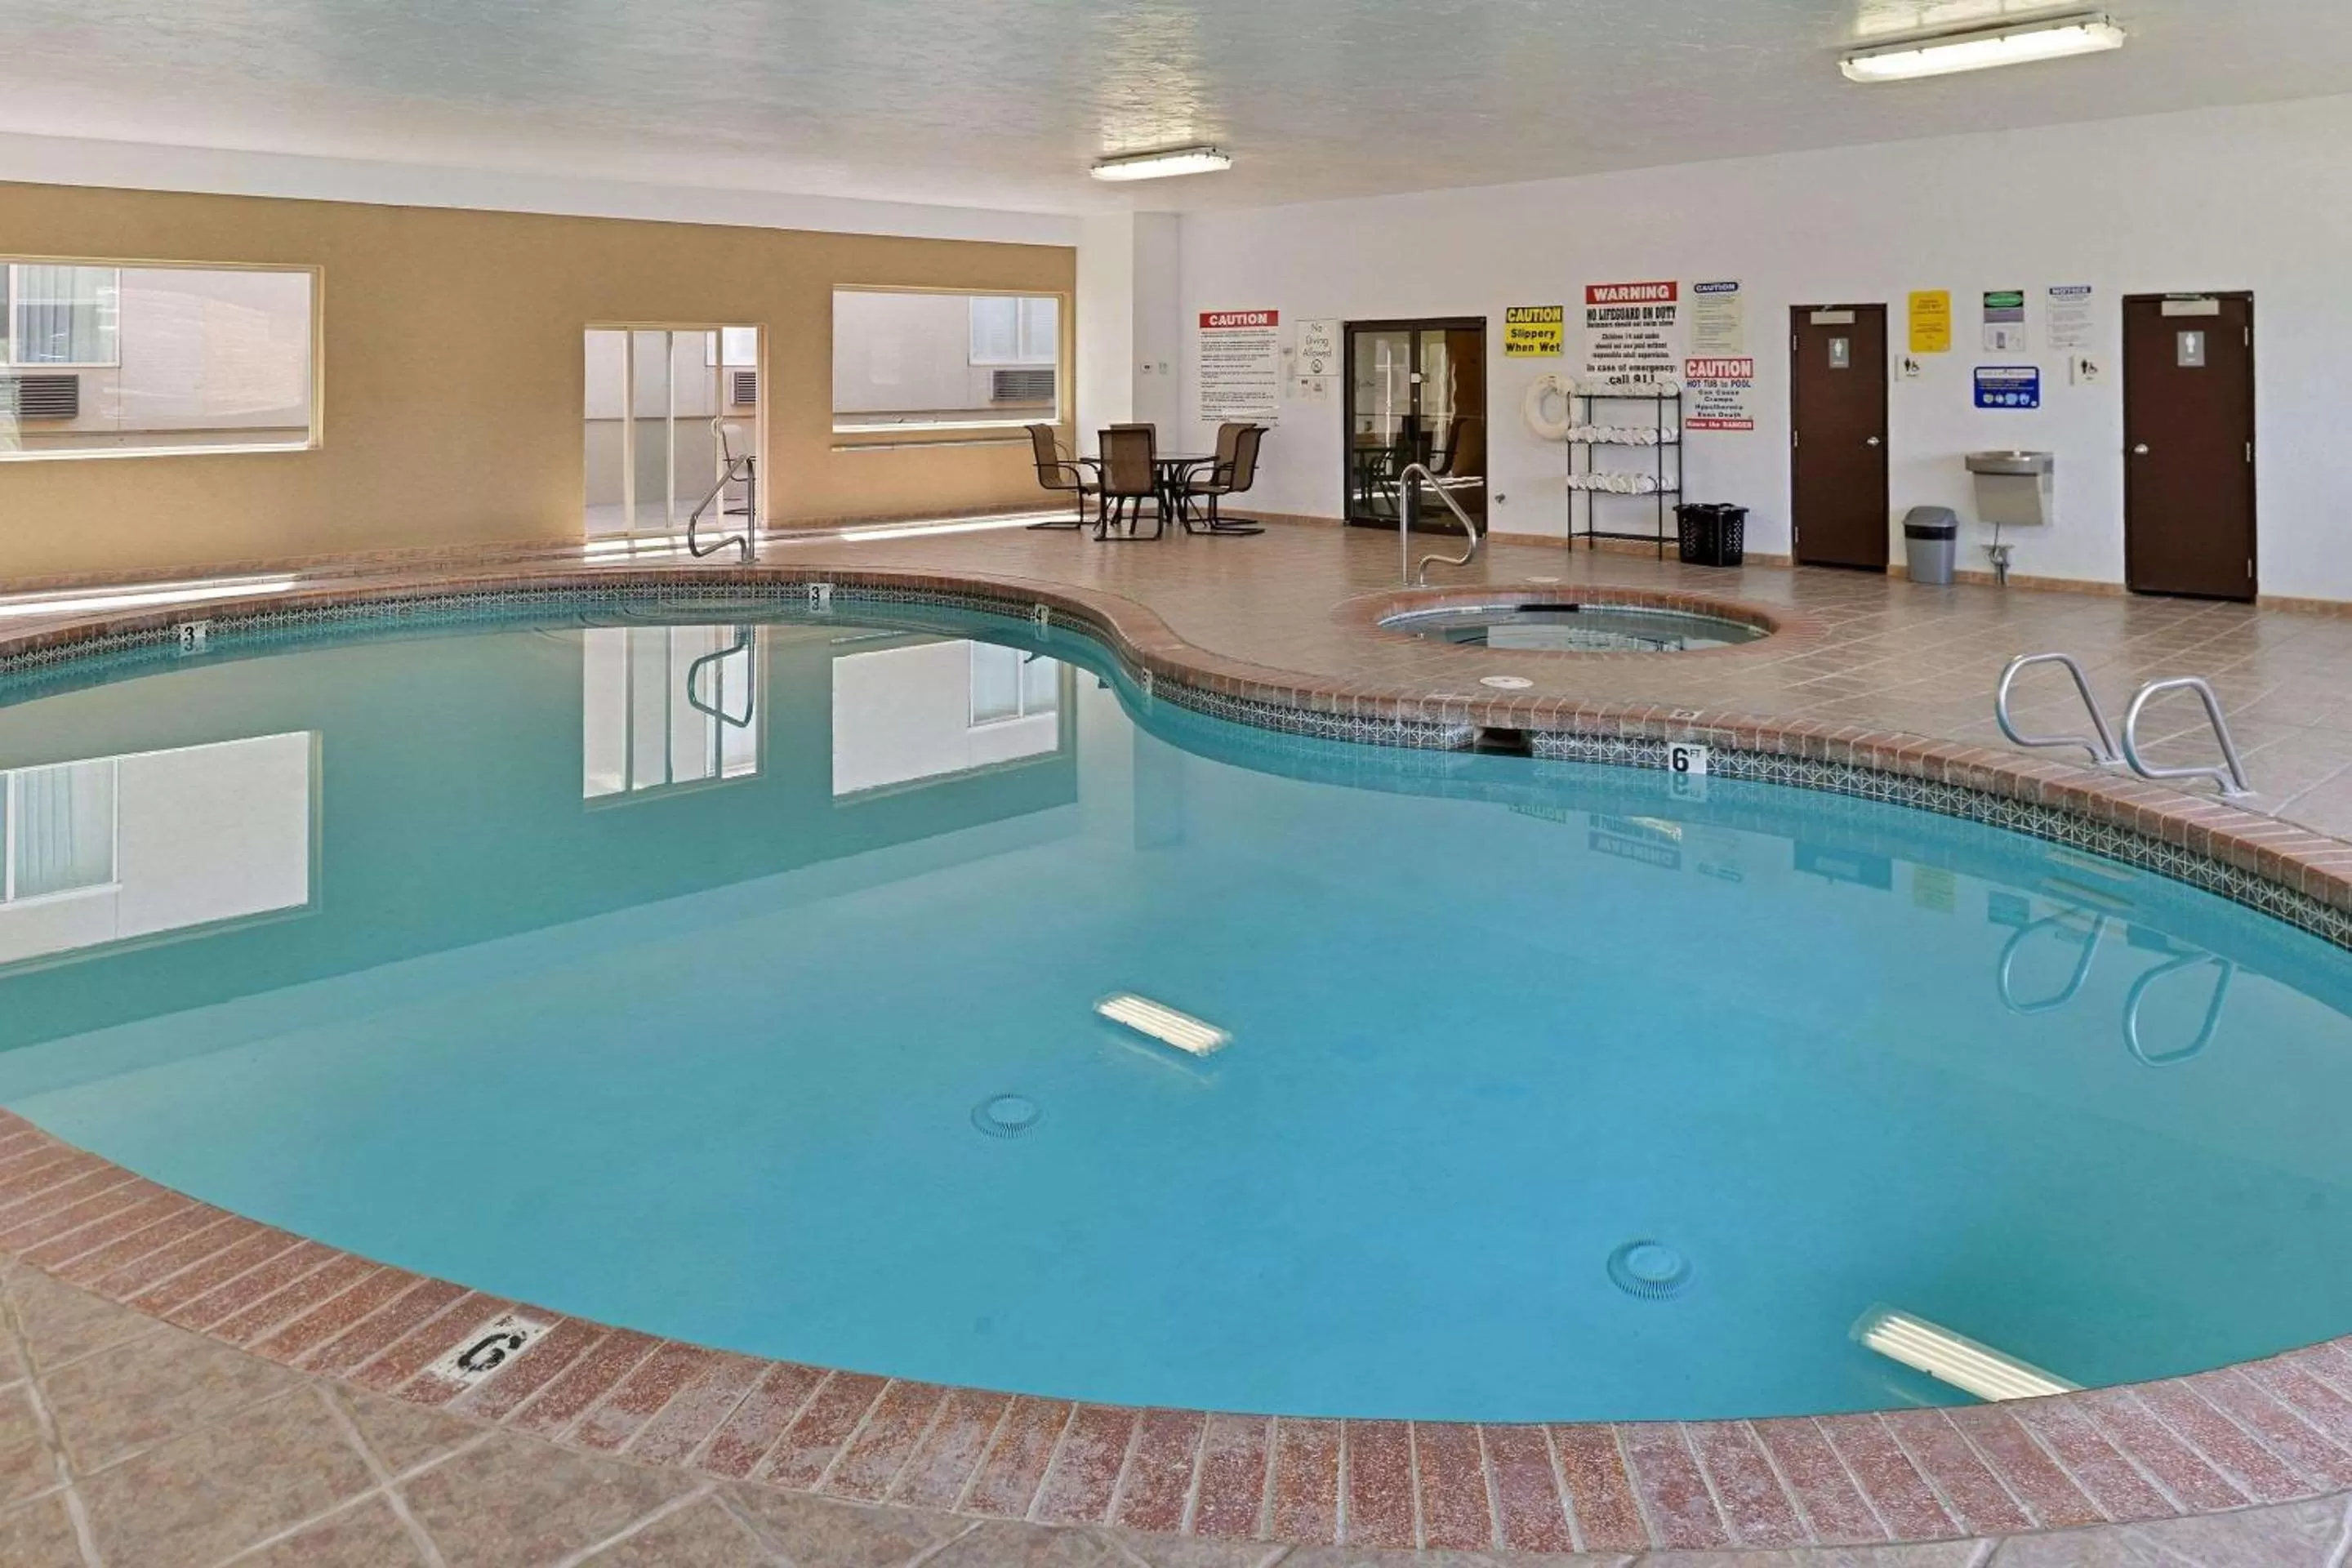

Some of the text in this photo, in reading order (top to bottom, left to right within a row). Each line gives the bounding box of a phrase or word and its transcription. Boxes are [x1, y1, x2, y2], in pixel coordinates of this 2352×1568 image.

[1593, 285, 1669, 301] WARNING
[1508, 308, 1561, 322] CAUTION
[1598, 307, 1640, 320] LIFEGUARD
[1642, 306, 1653, 319] ON
[1655, 305, 1677, 318] DUTY
[1209, 314, 1267, 326] CAUTION
[1310, 323, 1323, 332] No
[1511, 328, 1556, 340] Slippery
[1306, 334, 1330, 347] Diving
[1506, 342, 1561, 352] When Wet
[1303, 346, 1333, 358] Allowed
[1687, 360, 1751, 376] CAUTION
[1609, 374, 1655, 384] call 911
[1686, 380, 1701, 388] HOT
[1704, 380, 1717, 388] TUB
[1731, 380, 1751, 388] POOL
[812, 586, 820, 599] 3
[184, 626, 194, 641] 3
[1673, 747, 1701, 773] 6 FT
